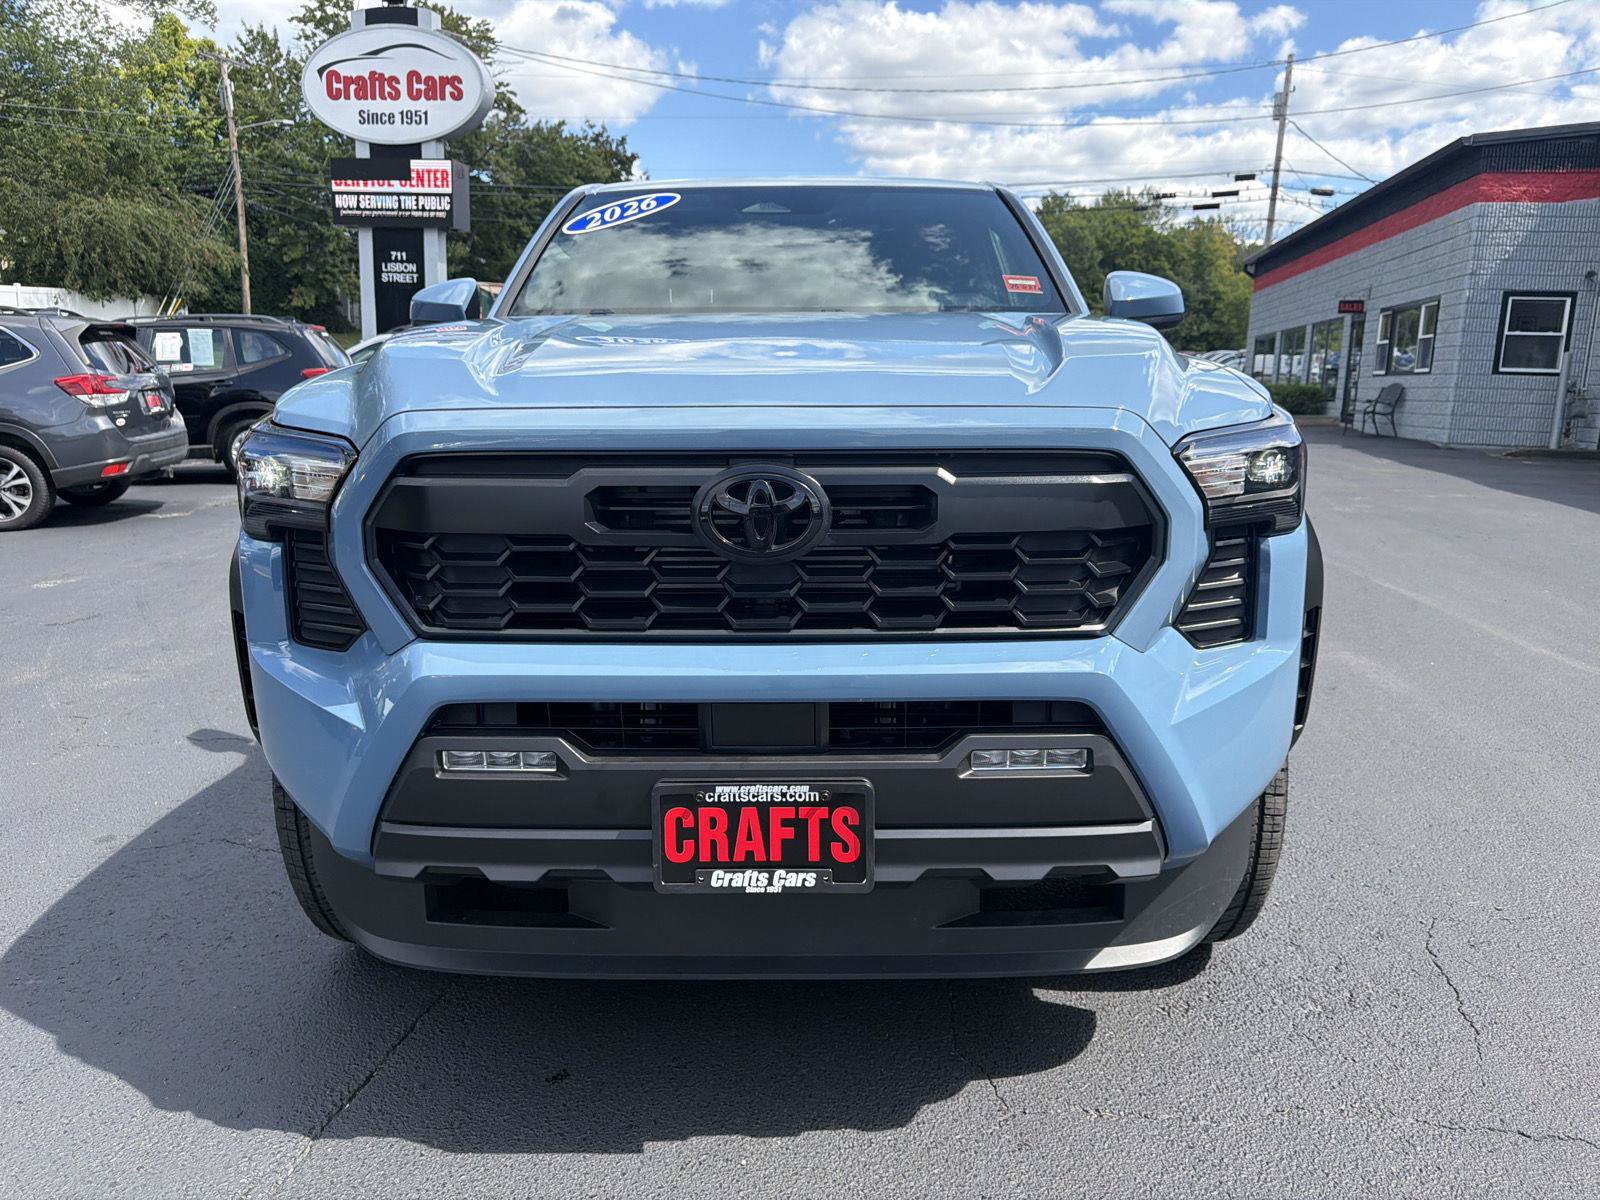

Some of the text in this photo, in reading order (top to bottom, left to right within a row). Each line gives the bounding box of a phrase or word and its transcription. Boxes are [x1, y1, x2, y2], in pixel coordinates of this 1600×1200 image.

[325, 69, 464, 101] Crafts Cars
[358, 109, 429, 126] Since 1951
[335, 194, 451, 211] NOW SERVING THE PUBLIC
[585, 195, 657, 230] 2026
[390, 251, 406, 261] 711
[381, 262, 417, 272] LISBON
[381, 274, 418, 283] STREET
[705, 789, 820, 802] craftscars.com
[715, 784, 810, 794] www.craftscars.com
[663, 805, 861, 864] CRAFTS
[710, 869, 817, 888] Crafts Cars
